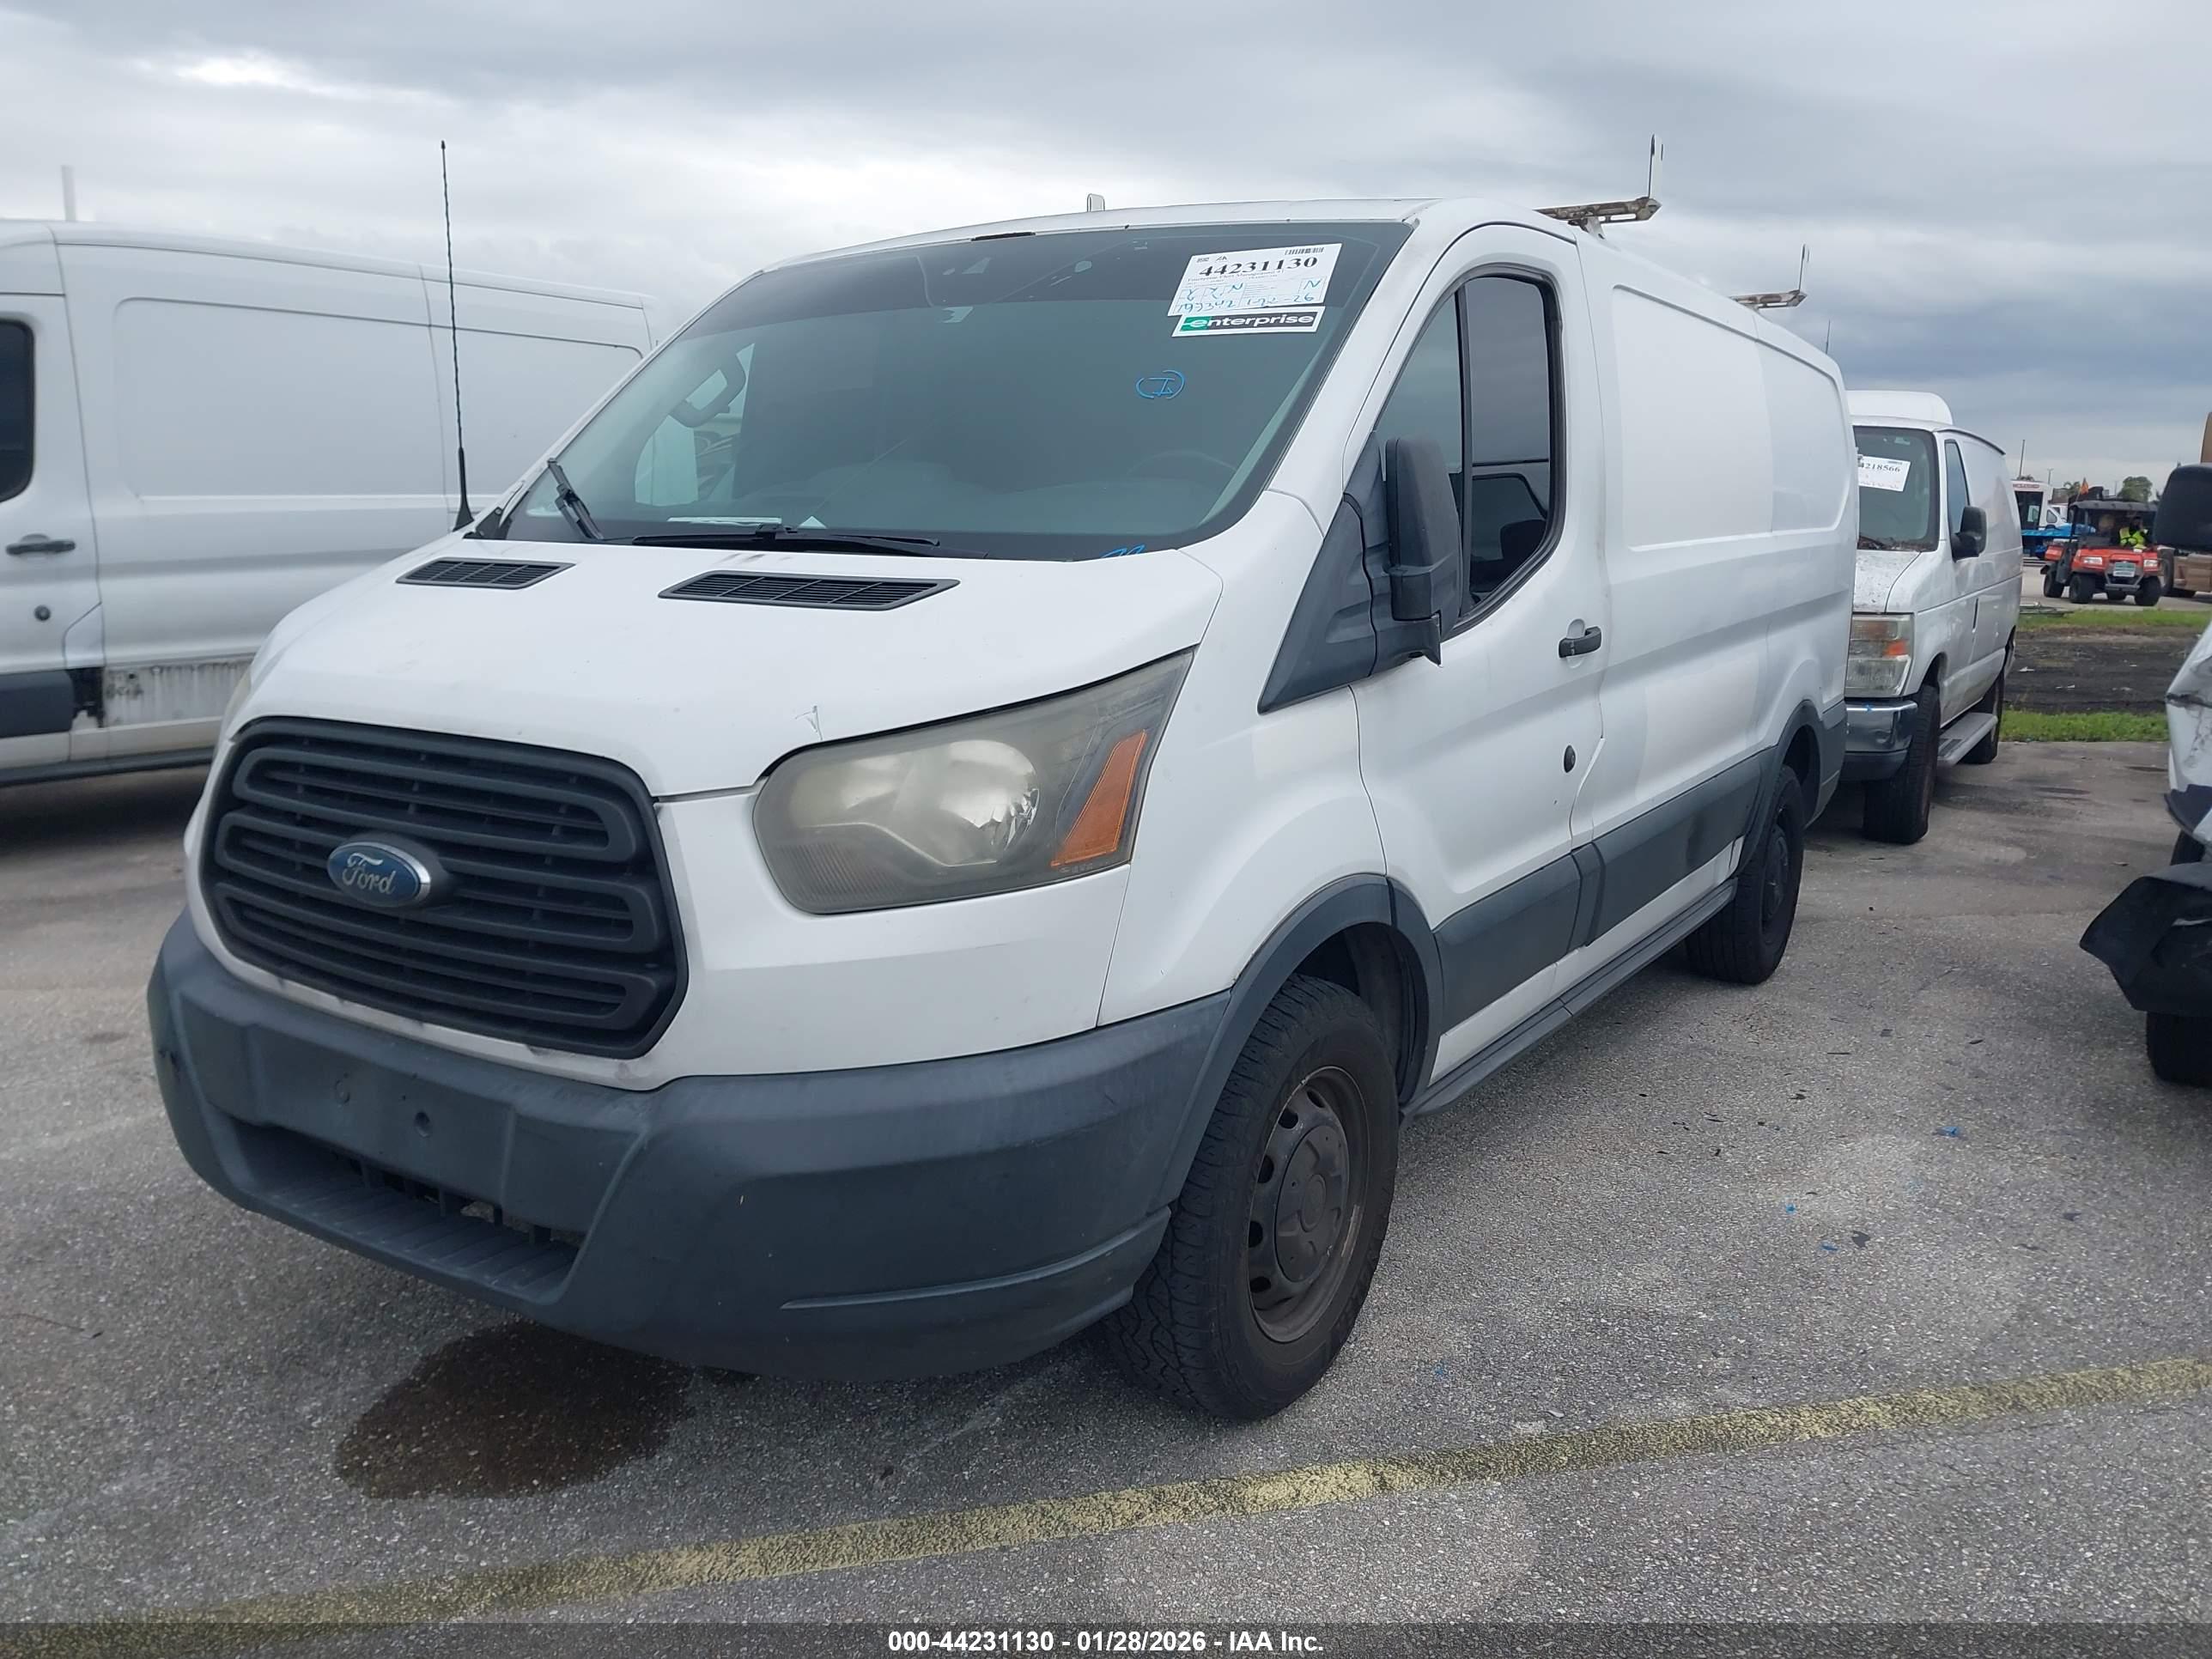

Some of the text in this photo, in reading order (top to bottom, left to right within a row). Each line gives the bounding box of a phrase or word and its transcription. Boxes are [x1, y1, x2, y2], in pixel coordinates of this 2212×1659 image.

[1200, 257, 1318, 276] 44231130
[1190, 314, 1314, 328] enterprise
[342, 852, 397, 895] Ford
